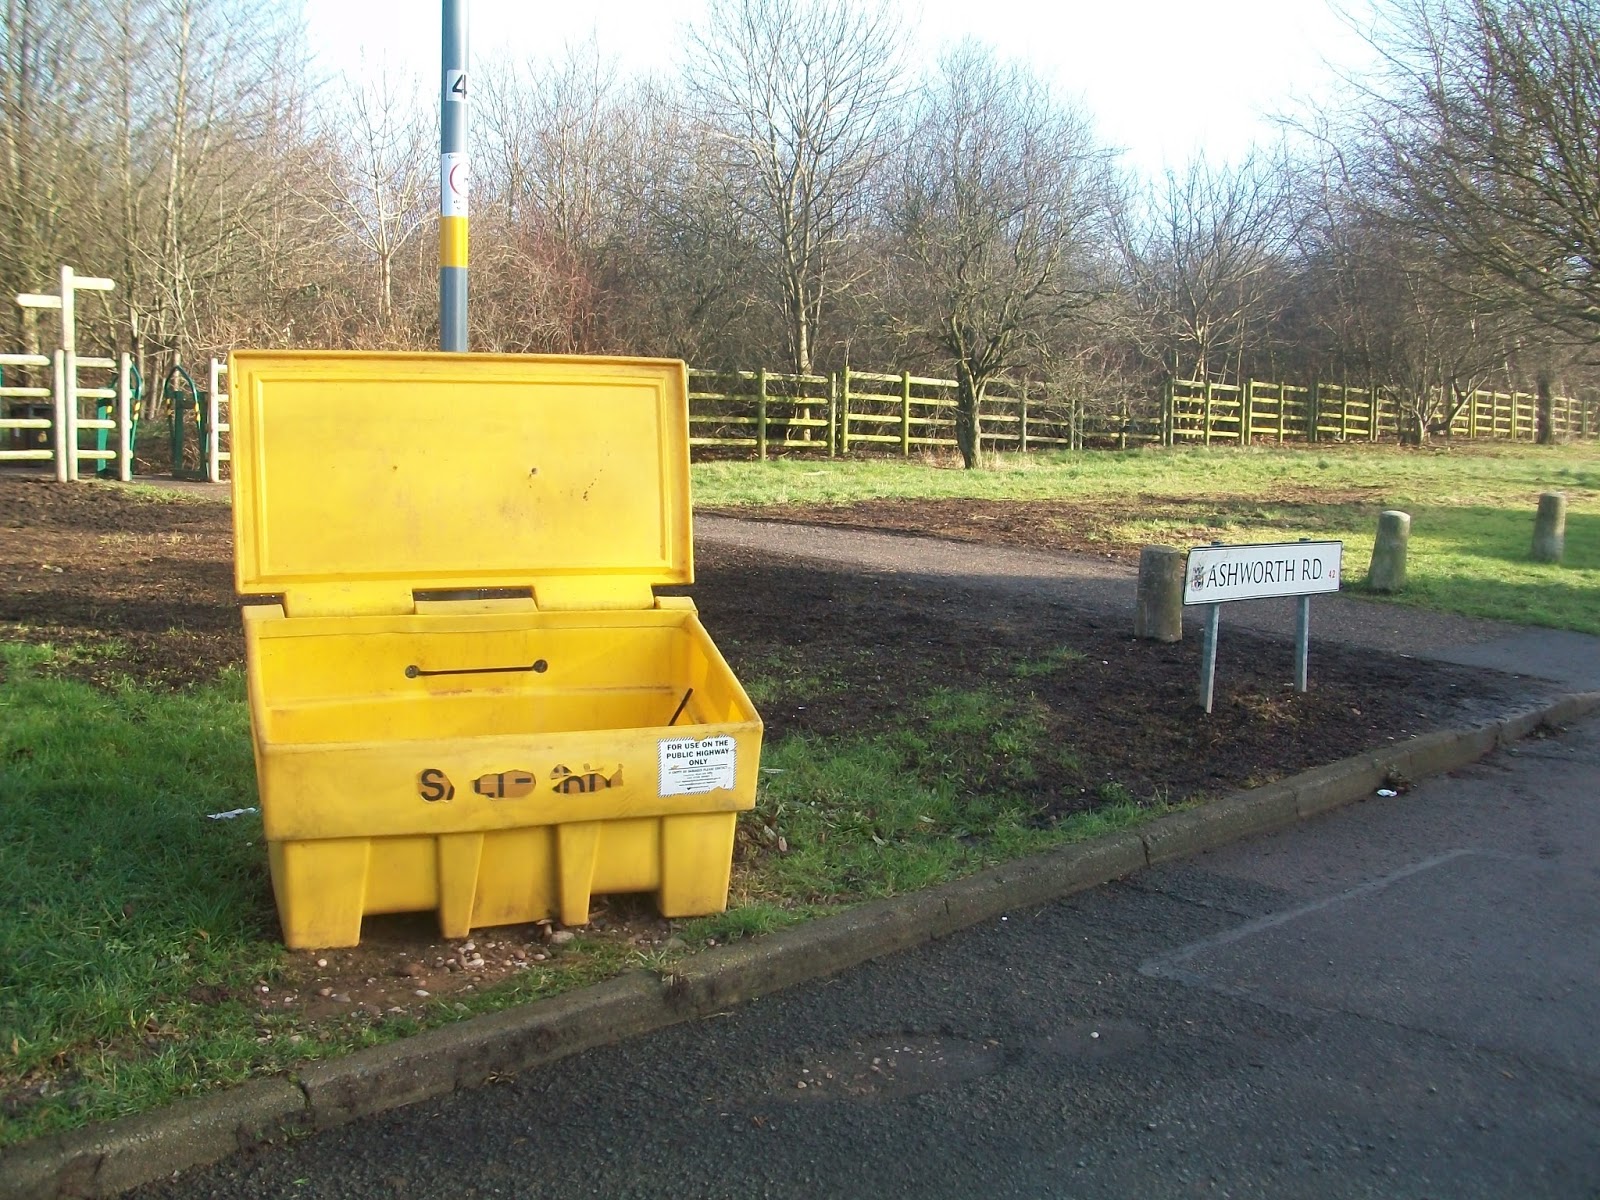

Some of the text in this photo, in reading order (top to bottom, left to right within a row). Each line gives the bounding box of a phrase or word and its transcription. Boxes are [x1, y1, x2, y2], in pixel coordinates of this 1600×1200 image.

[452, 74, 467, 99] 4
[1206, 559, 1296, 588] ASHWORTH
[667, 743, 682, 751] FOR
[701, 740, 713, 748] ON
[715, 739, 729, 747] THE
[666, 748, 729, 759] PUBLIC HIGHWAY
[688, 758, 708, 766] ONLY
